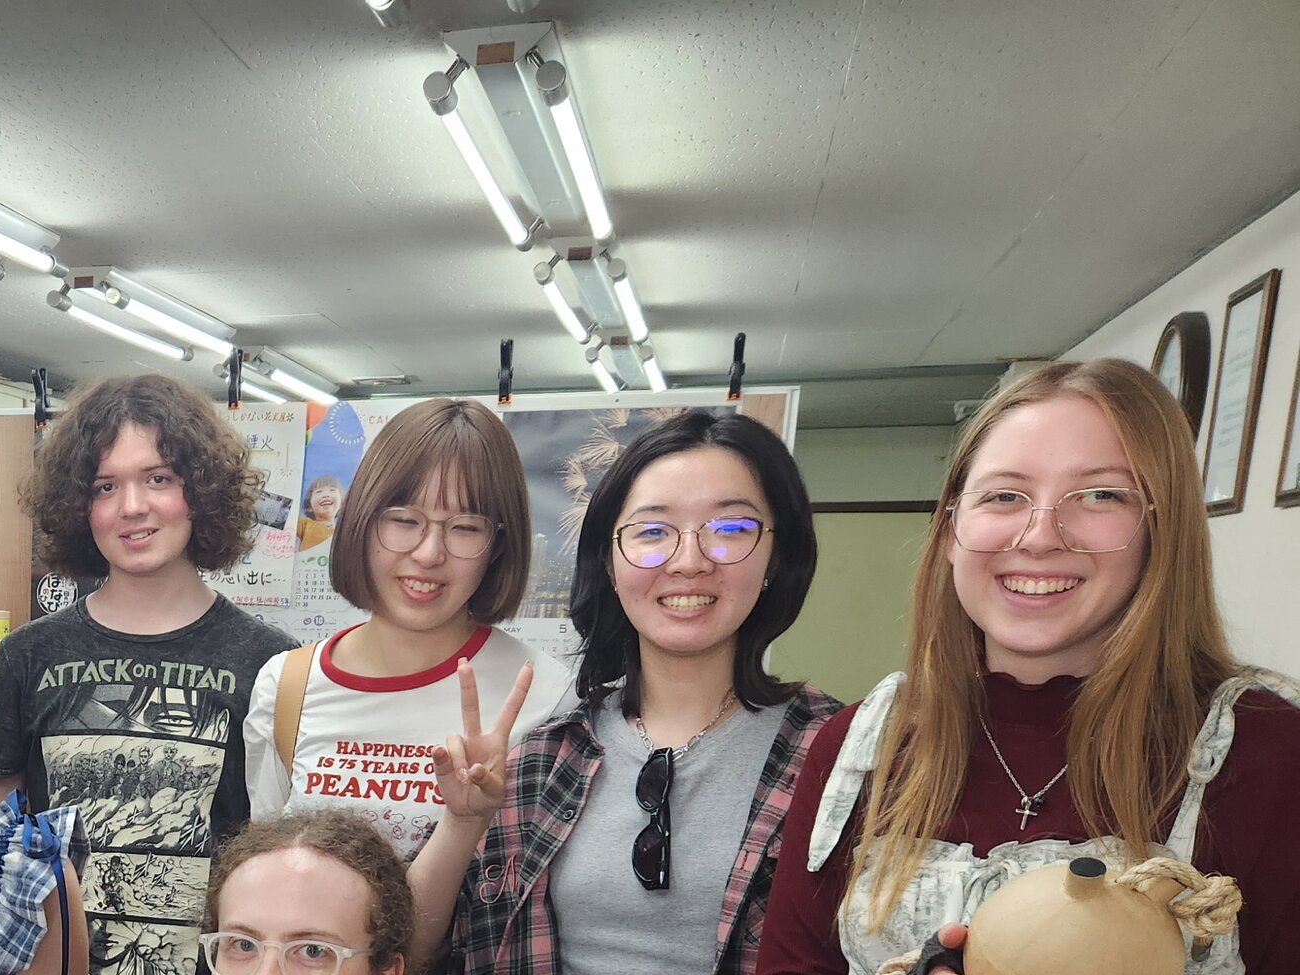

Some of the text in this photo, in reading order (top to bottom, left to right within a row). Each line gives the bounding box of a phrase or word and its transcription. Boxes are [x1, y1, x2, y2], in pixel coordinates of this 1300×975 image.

[559, 624, 567, 634] 5
[37, 658, 133, 692] ATTACK
[132, 663, 157, 679] on
[336, 741, 433, 758] HAPPINESS
[317, 756, 335, 768] IS
[338, 758, 357, 770] 75
[361, 760, 420, 774] YEARS
[304, 772, 446, 805] PEANUTS
